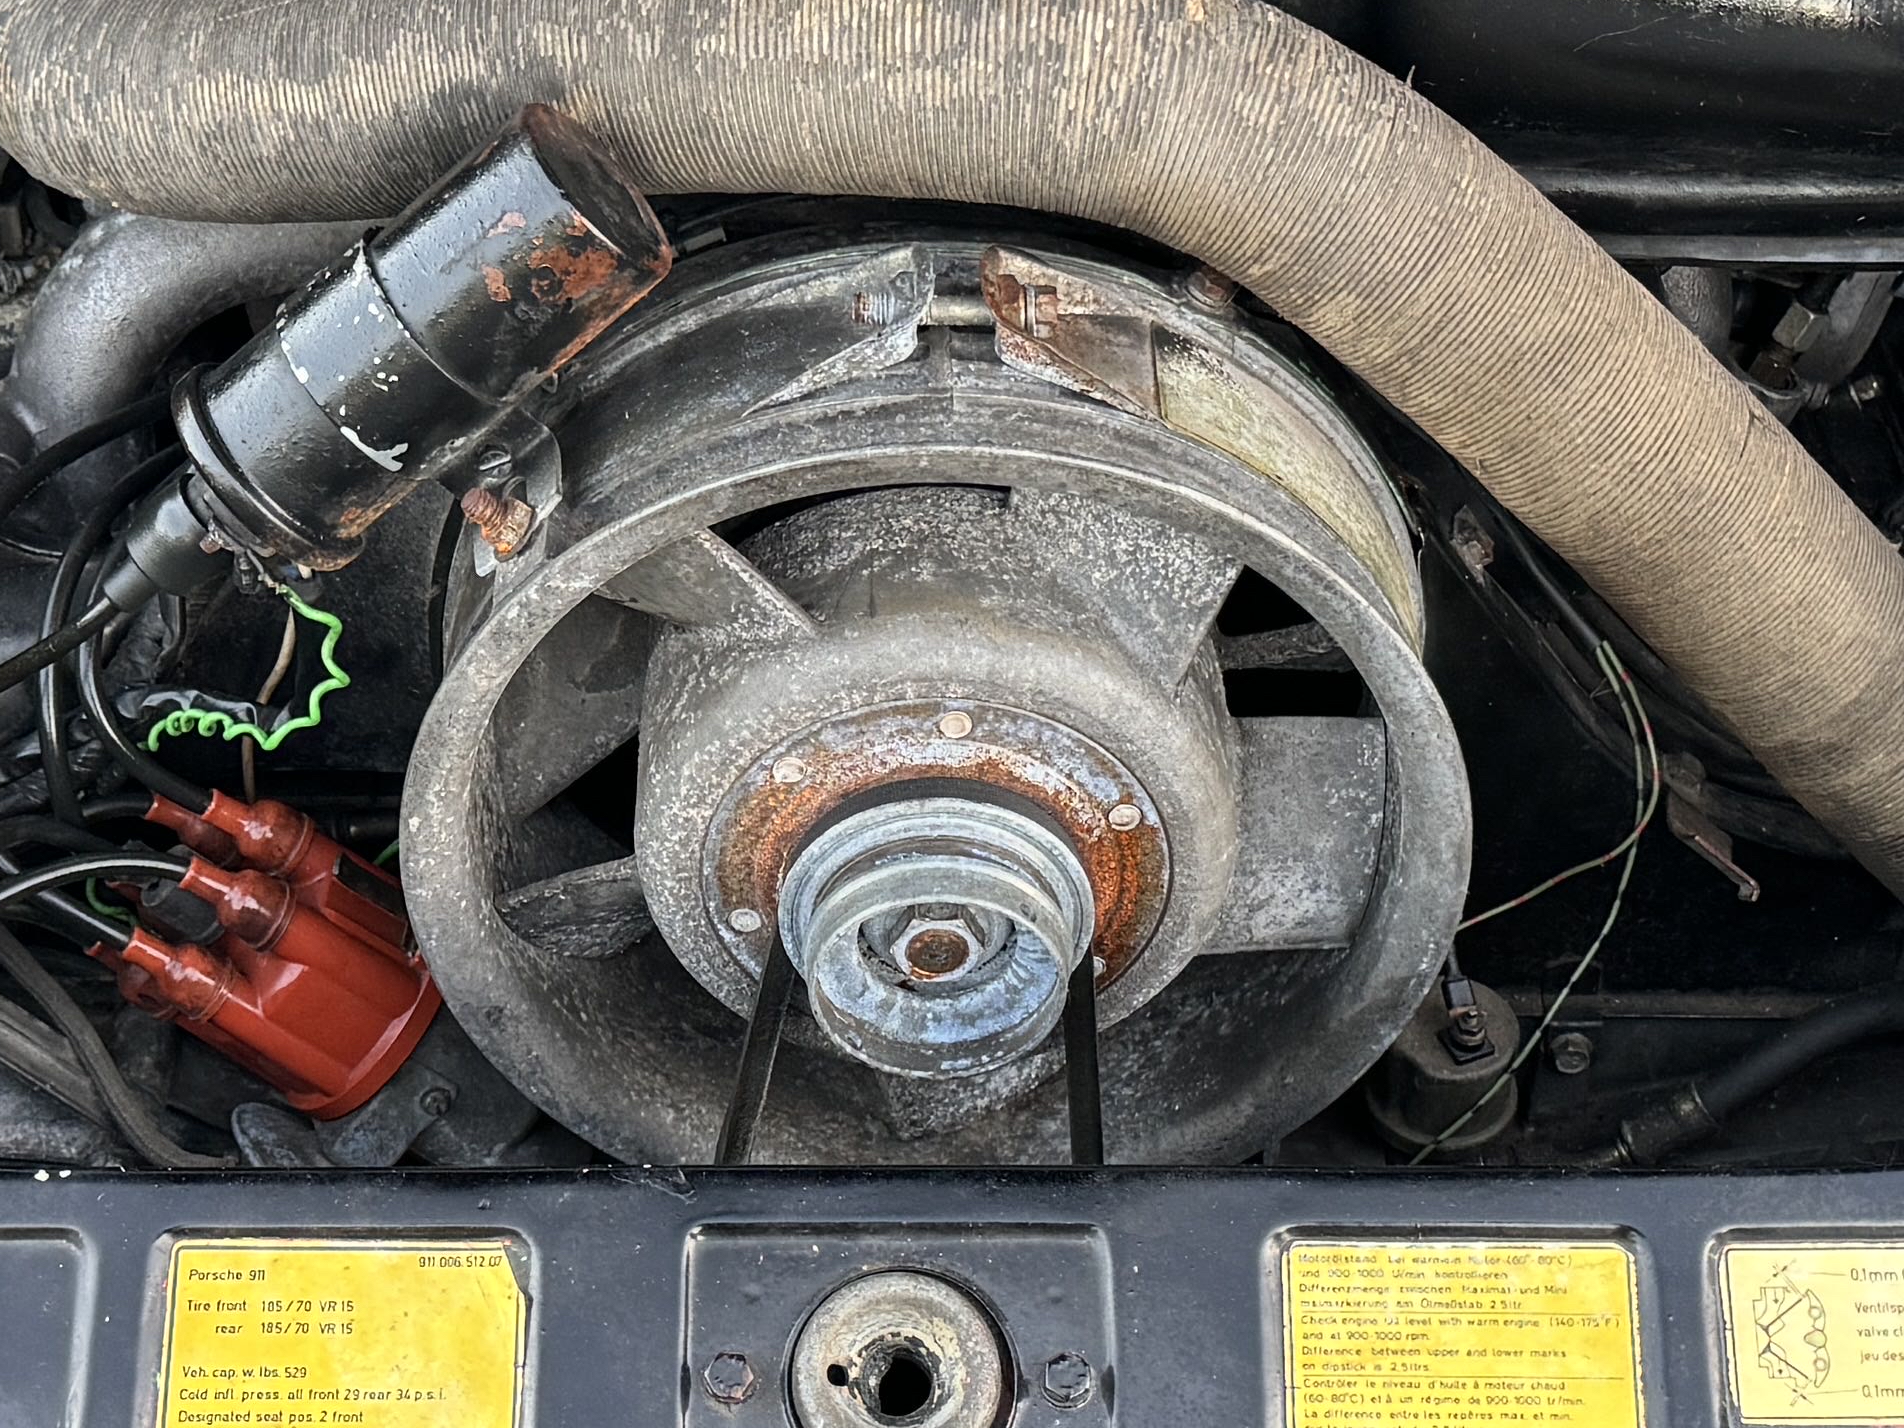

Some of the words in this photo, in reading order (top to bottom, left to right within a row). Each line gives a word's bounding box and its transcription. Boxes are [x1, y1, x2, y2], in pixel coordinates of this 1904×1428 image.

[189, 1269, 242, 1280] Porsche
[249, 1269, 265, 1281] 911
[187, 1300, 211, 1311] Tire
[216, 1300, 247, 1311] front
[319, 1300, 337, 1312] VR
[215, 1325, 243, 1333] rear
[318, 1322, 336, 1334] VR
[1341, 1317, 1378, 1327] engine
[1405, 1316, 1432, 1325] level
[1438, 1317, 1462, 1325] with
[1467, 1318, 1499, 1326] warm
[1503, 1318, 1540, 1328] engine
[1302, 1331, 1323, 1340] and
[1856, 1326, 1889, 1337] valve
[1302, 1346, 1362, 1356] Difference
[1371, 1346, 1421, 1356] between
[1427, 1348, 1460, 1357] upper
[1466, 1348, 1487, 1357] and
[1492, 1348, 1523, 1357] lower
[1530, 1348, 1567, 1358] marks
[1883, 1350, 1904, 1361] des
[182, 1366, 209, 1377] Veh.
[285, 1367, 307, 1378] 529
[1322, 1362, 1366, 1371] dipstick
[1366, 1379, 1376, 1388] le
[1382, 1380, 1421, 1389] niveau
[1484, 1381, 1525, 1390] moteur
[1531, 1381, 1565, 1390] chaud
[179, 1388, 208, 1400] Cold
[288, 1389, 303, 1400] all
[308, 1389, 339, 1400] front
[344, 1388, 360, 1400] 29
[363, 1391, 391, 1400] rear
[395, 1388, 410, 1400] 34
[178, 1410, 251, 1425] Designated
[256, 1410, 283, 1422] seat
[319, 1410, 328, 1422] 2
[332, 1411, 363, 1422] front
[1389, 1410, 1419, 1419] entre
[1424, 1410, 1441, 1419] les
